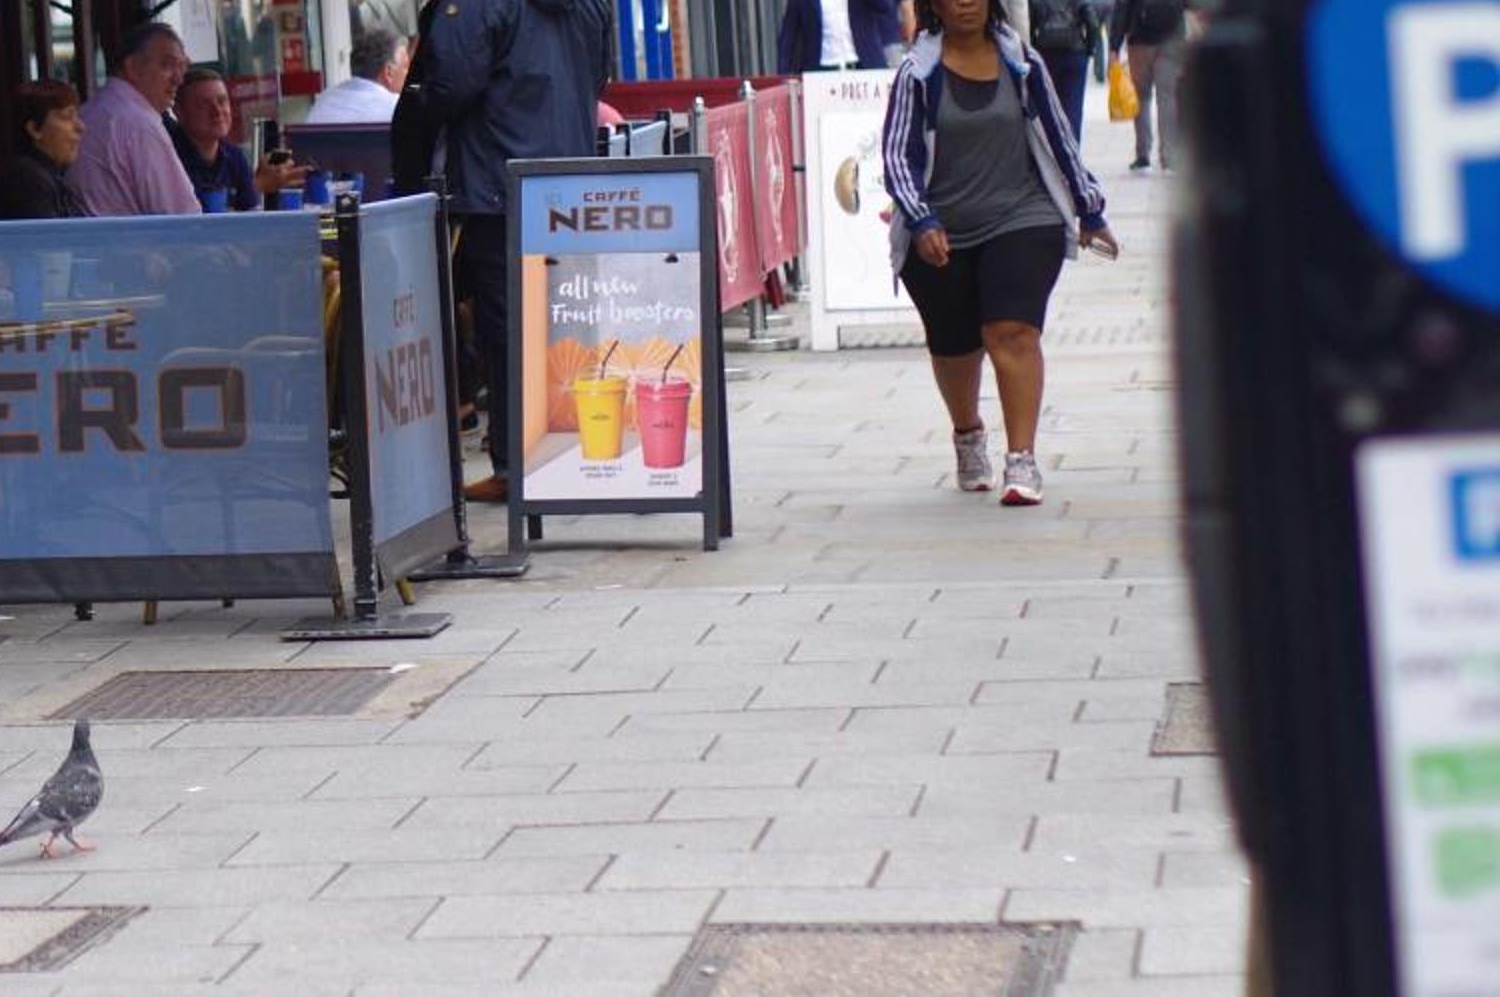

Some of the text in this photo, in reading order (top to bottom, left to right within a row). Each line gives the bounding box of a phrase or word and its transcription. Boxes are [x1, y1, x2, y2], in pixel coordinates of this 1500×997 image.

[549, 204, 674, 232] NERO
[559, 274, 638, 300] all new
[608, 297, 694, 325] boosters
[374, 336, 436, 437] NERO
